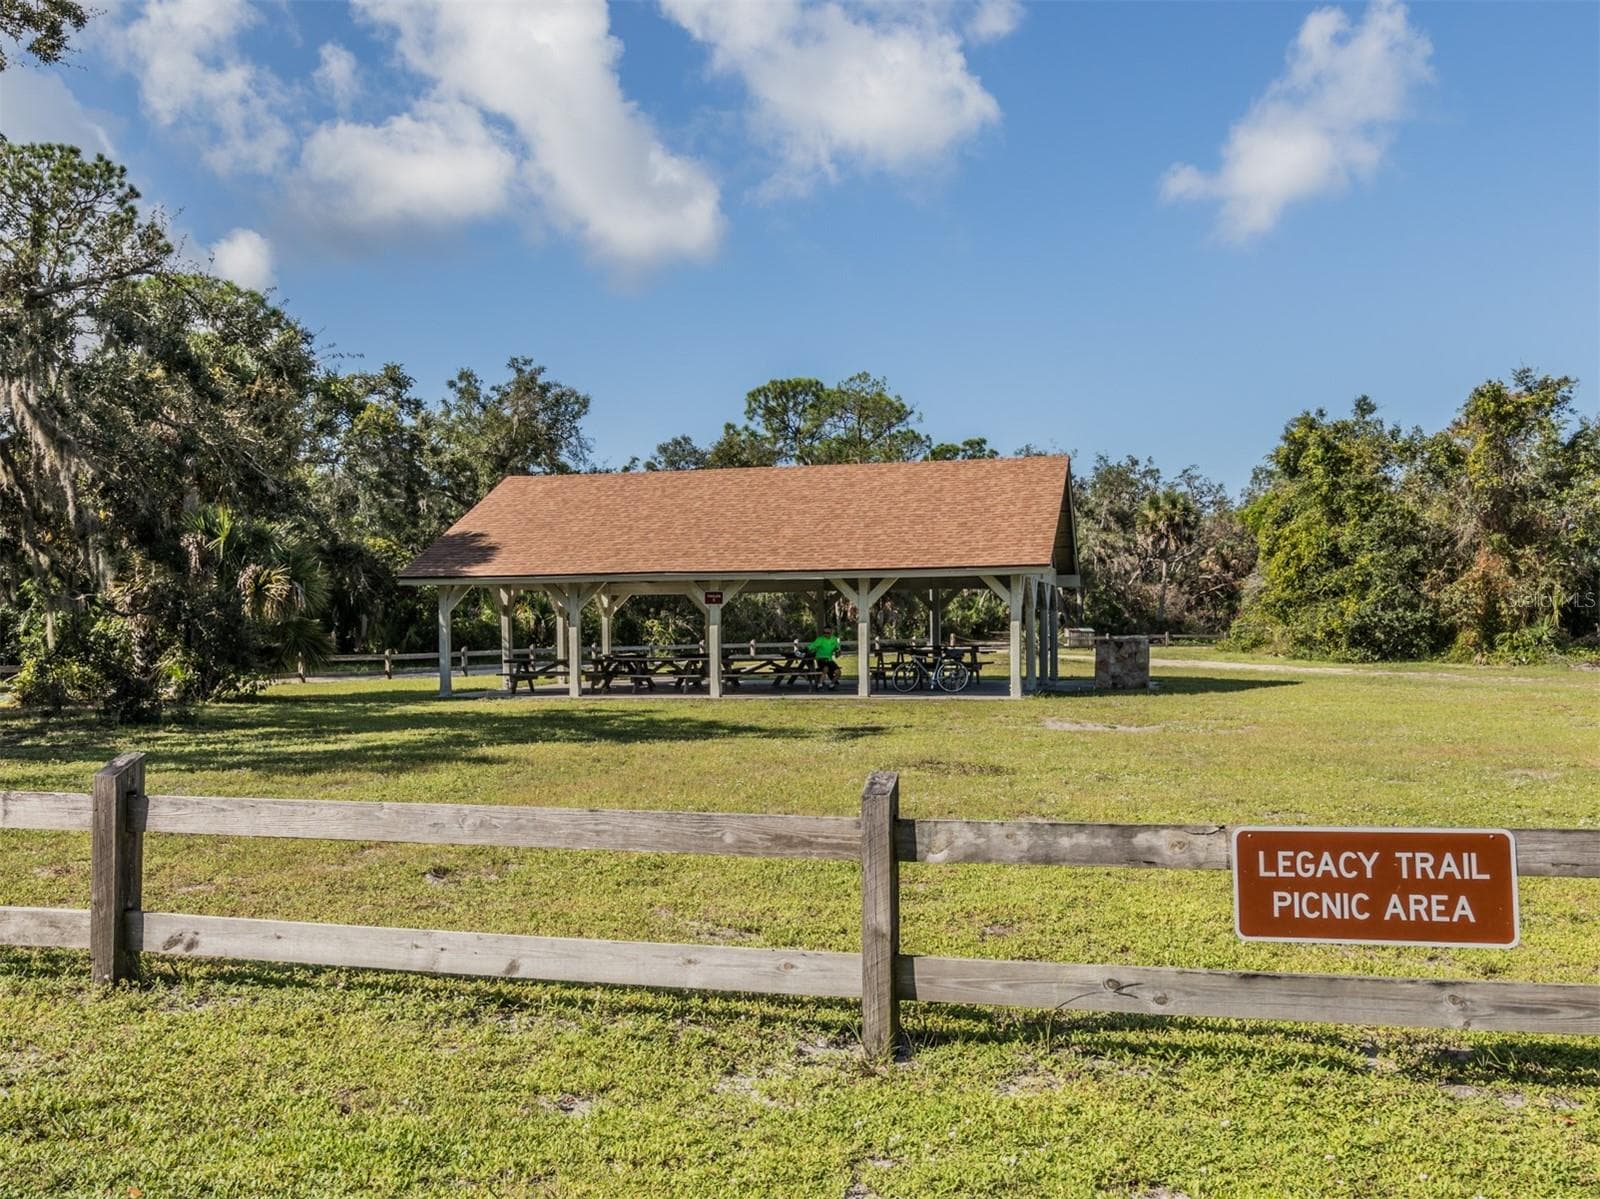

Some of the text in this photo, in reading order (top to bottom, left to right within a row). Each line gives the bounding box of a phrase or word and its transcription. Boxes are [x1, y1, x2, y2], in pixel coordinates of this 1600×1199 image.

[1258, 850, 1490, 880] LEGACY TRAIL
[1273, 891, 1476, 923] PICNIC AREA
